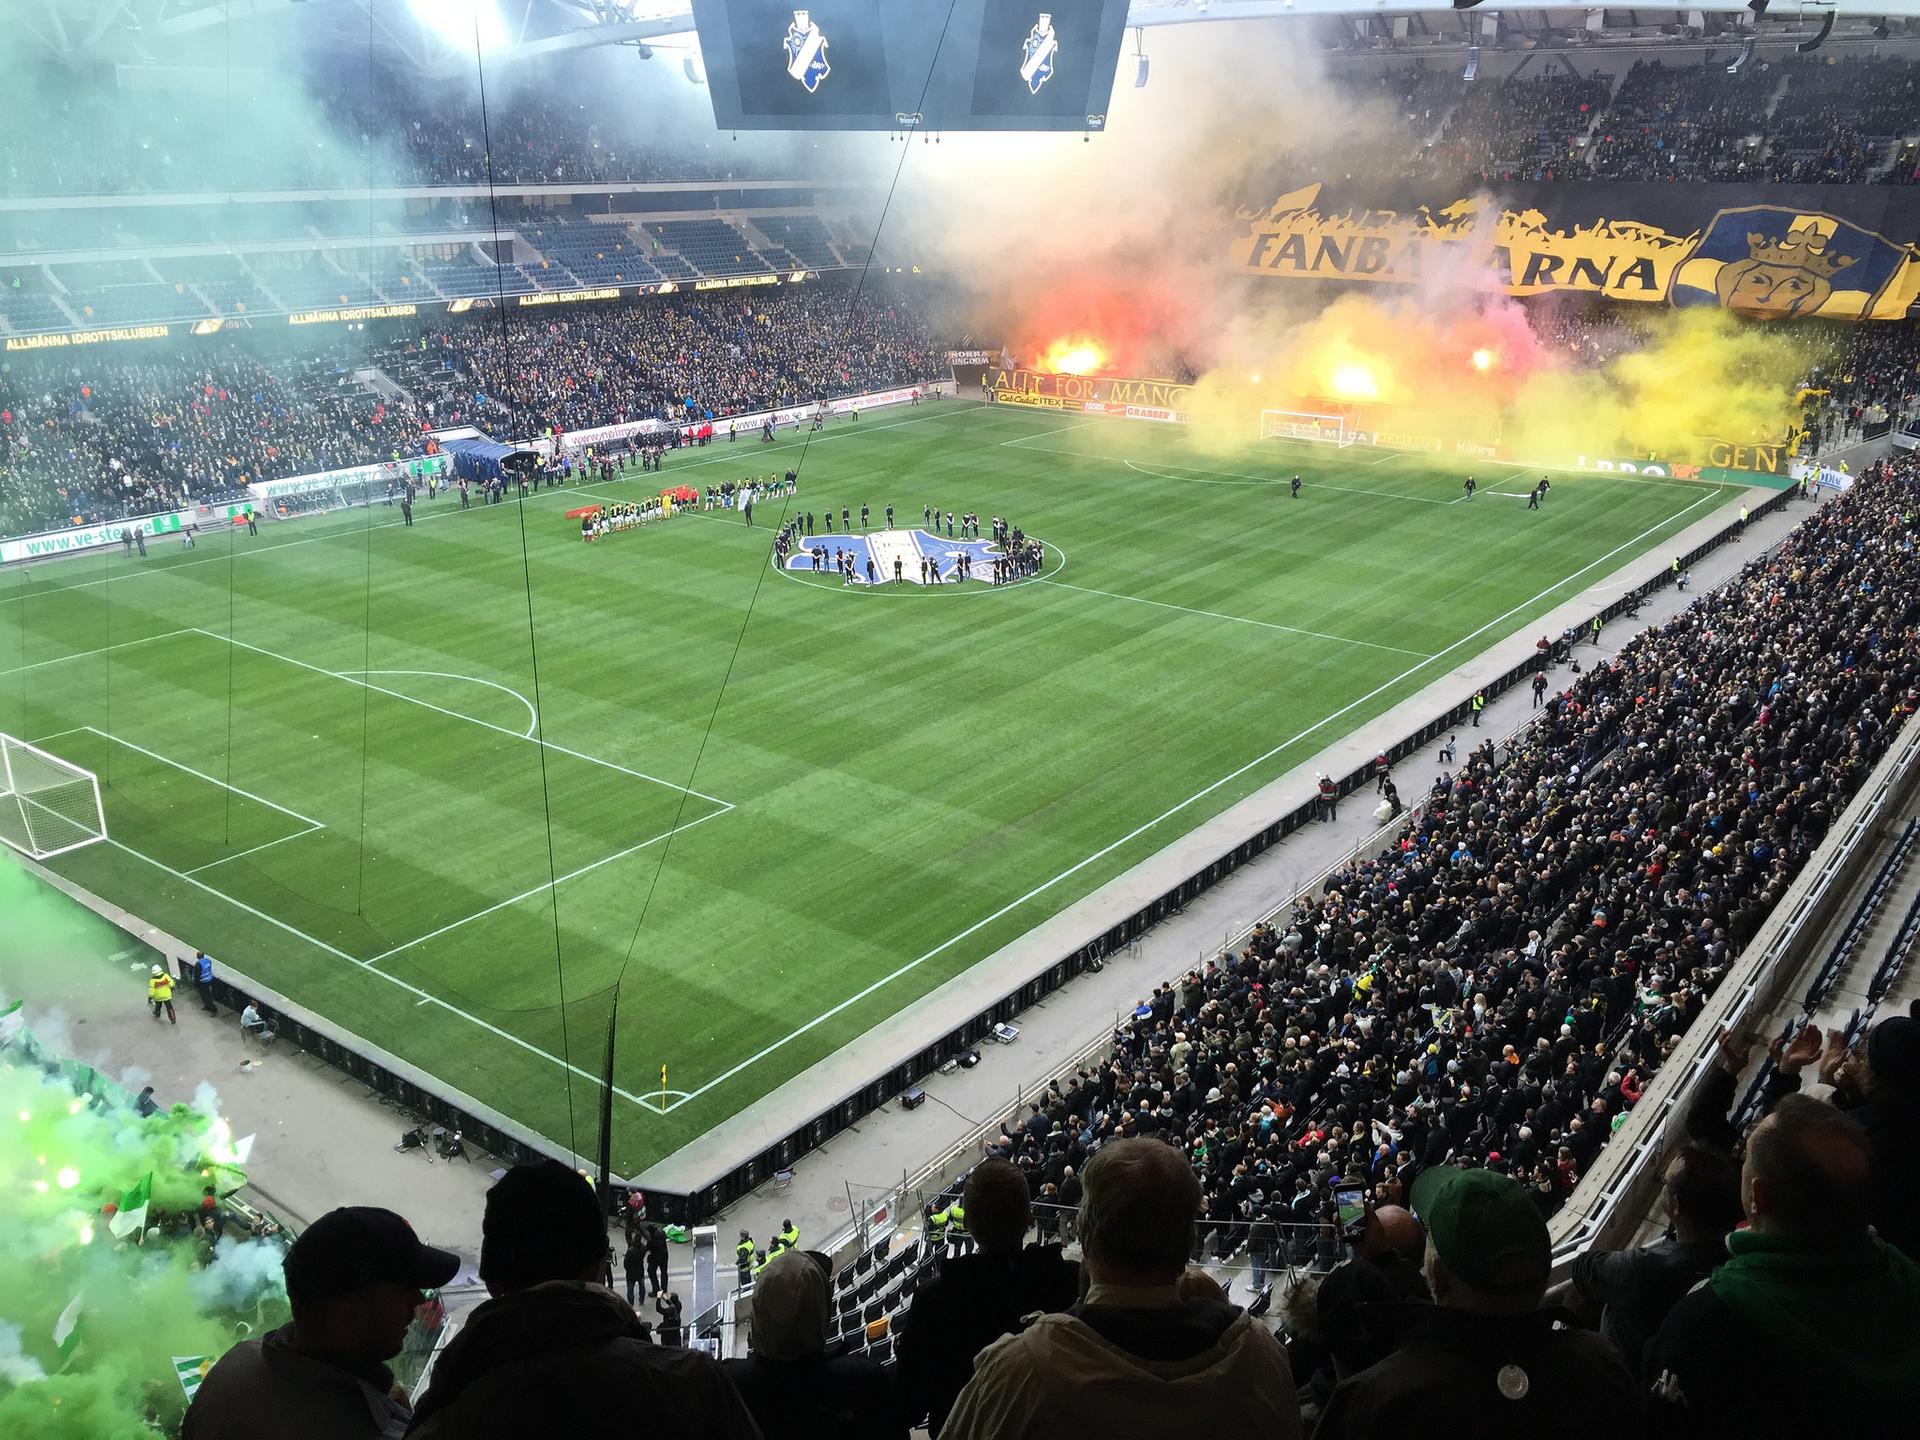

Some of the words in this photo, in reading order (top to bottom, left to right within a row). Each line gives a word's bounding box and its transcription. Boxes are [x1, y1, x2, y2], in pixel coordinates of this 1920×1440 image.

[340, 305, 417, 321] IDROTTSKLUBBEN
[72, 325, 168, 344] IDROTTSKLUBBEN
[1127, 405, 1170, 420] GRABBER
[1324, 428, 1368, 442] MDA
[26, 522, 153, 555] www.ve-stee
